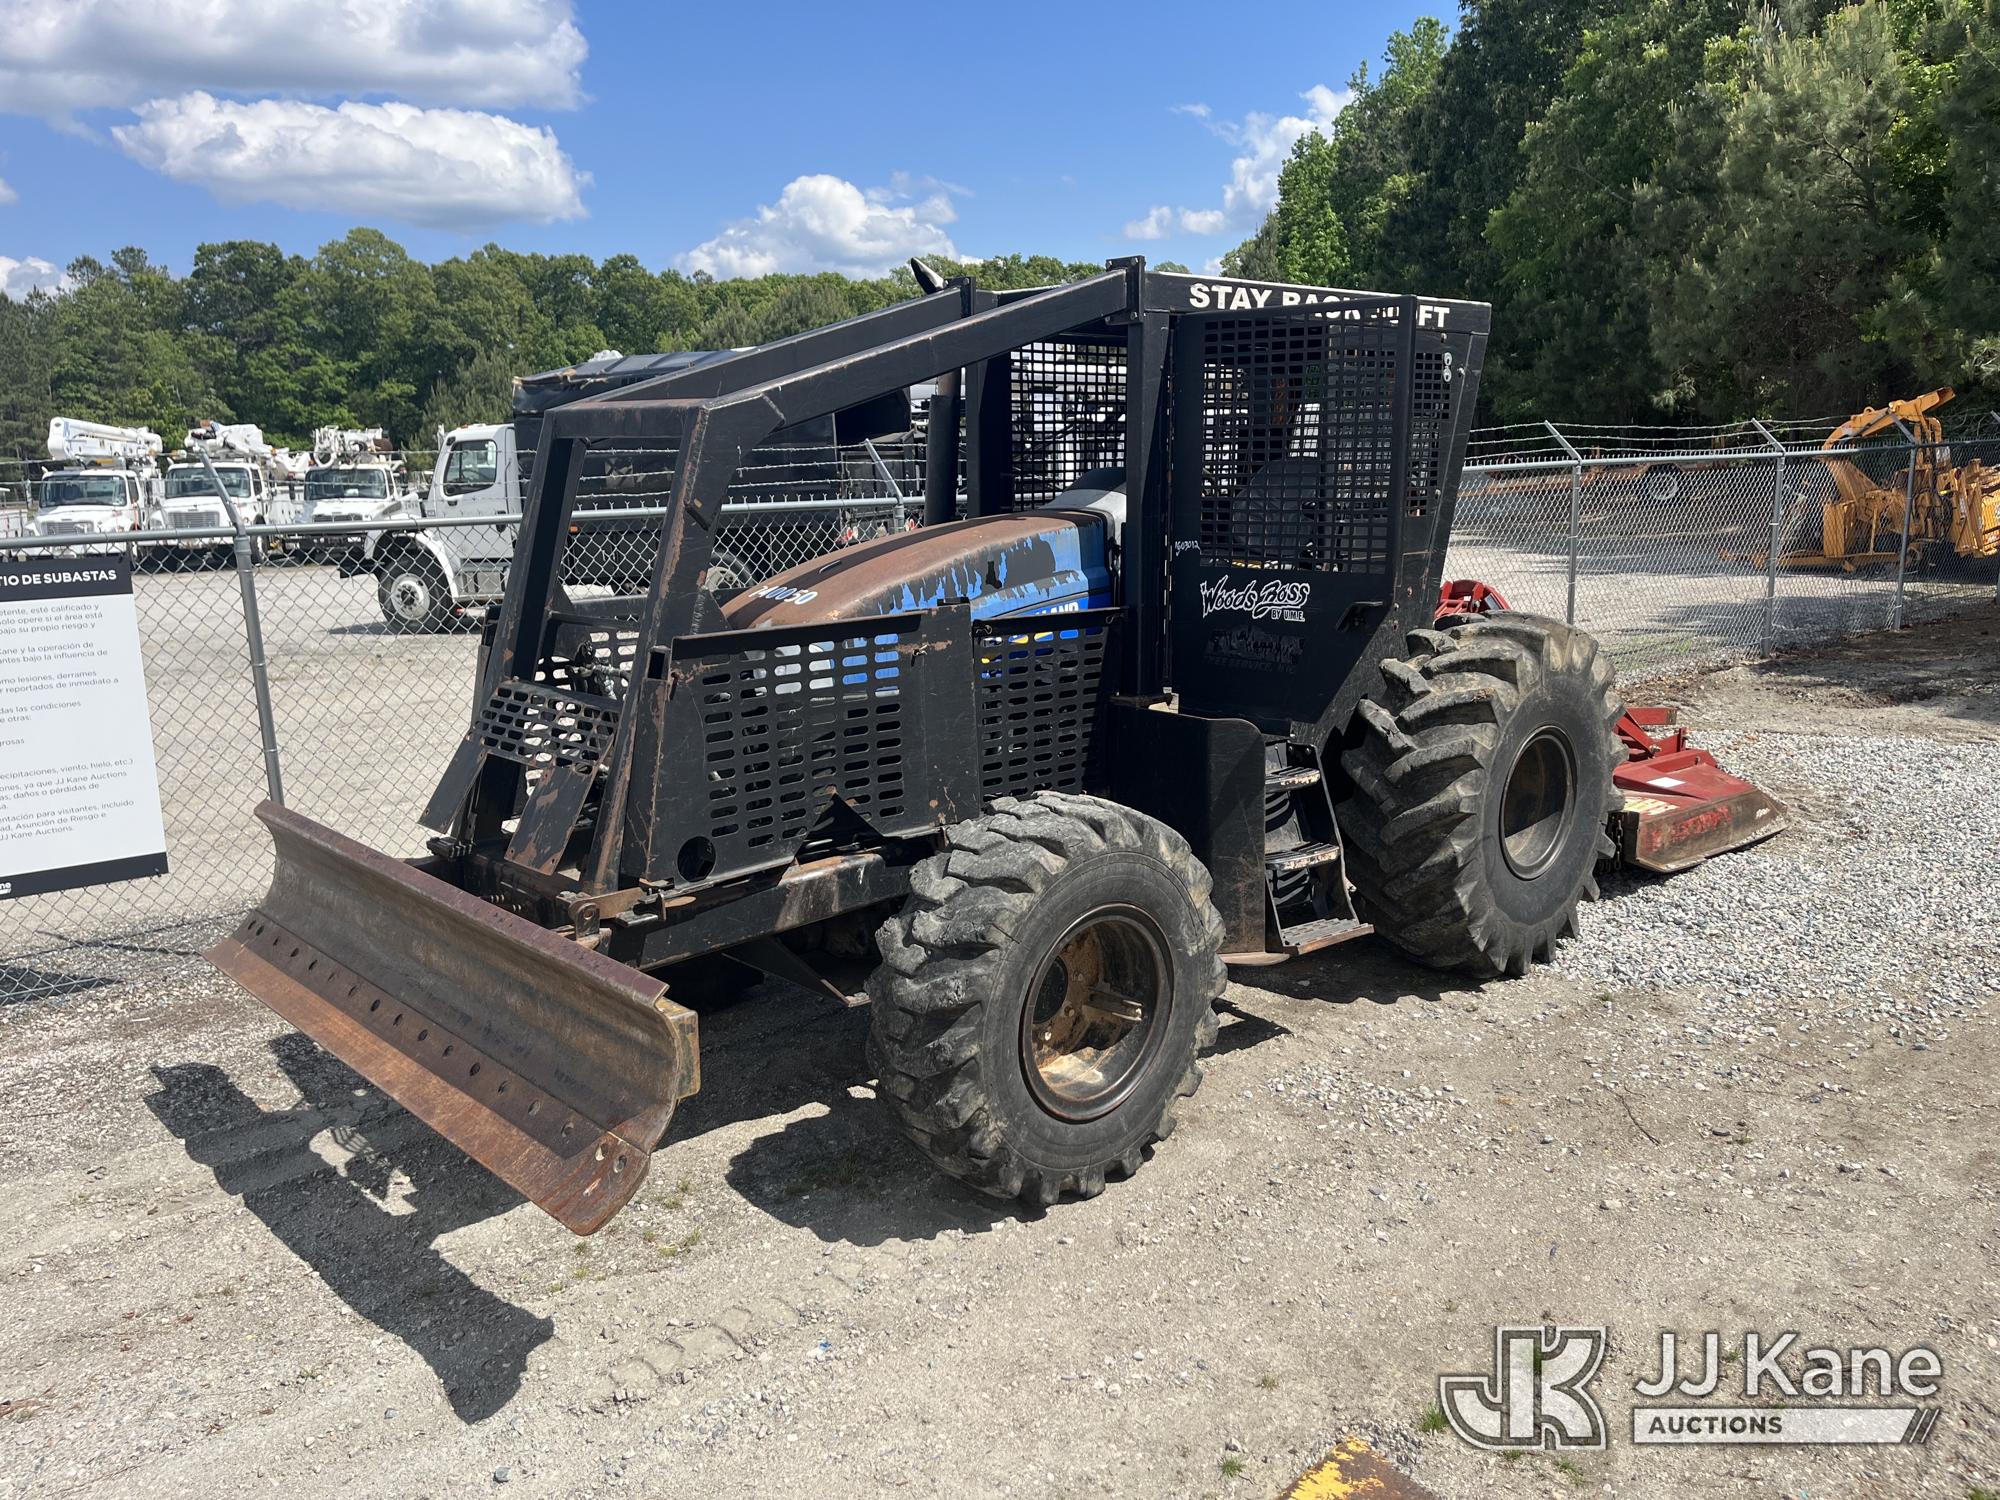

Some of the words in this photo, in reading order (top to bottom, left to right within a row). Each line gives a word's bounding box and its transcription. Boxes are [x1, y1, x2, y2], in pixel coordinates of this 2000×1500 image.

[1189, 283, 1272, 310] STAY
[1418, 305, 1450, 328] FT
[22, 573, 42, 585] DE
[43, 569, 117, 584] SUBASTAS
[1200, 574, 1258, 619] Woods
[1252, 579, 1311, 619] Boss
[51, 603, 92, 613] calificado
[1270, 608, 1282, 619] BY
[18, 617, 43, 625] opere
[45, 614, 52, 622] si
[64, 611, 83, 621] área
[85, 611, 103, 619] está
[20, 626, 29, 634] su
[31, 624, 60, 634] propio
[62, 621, 89, 631] riesgo
[28, 645, 36, 653] la
[38, 642, 81, 653] operación
[83, 641, 94, 649] de
[23, 654, 42, 664] bajo
[44, 653, 52, 661] la
[54, 650, 95, 660] influencia
[18, 674, 55, 683] lesiones,
[57, 671, 97, 680] derrames
[6, 683, 54, 694] reportados
[56, 681, 67, 689] de
[69, 678, 112, 688] inmediato
[16, 705, 28, 713] las
[31, 700, 82, 711] condiciones
[60, 763, 88, 773] viento,
[91, 759, 113, 769] hielo,
[67, 775, 88, 784] Kane
[91, 770, 128, 780] Auctions
[14, 790, 40, 800] daños
[50, 785, 87, 796] pérdidas
[89, 782, 100, 790] de
[37, 810, 56, 819] para
[58, 805, 99, 815] visitantes,
[102, 800, 135, 809] incluido
[16, 820, 55, 830] Asunción
[70, 812, 99, 823] Riesgo
[11, 831, 32, 840] Kane
